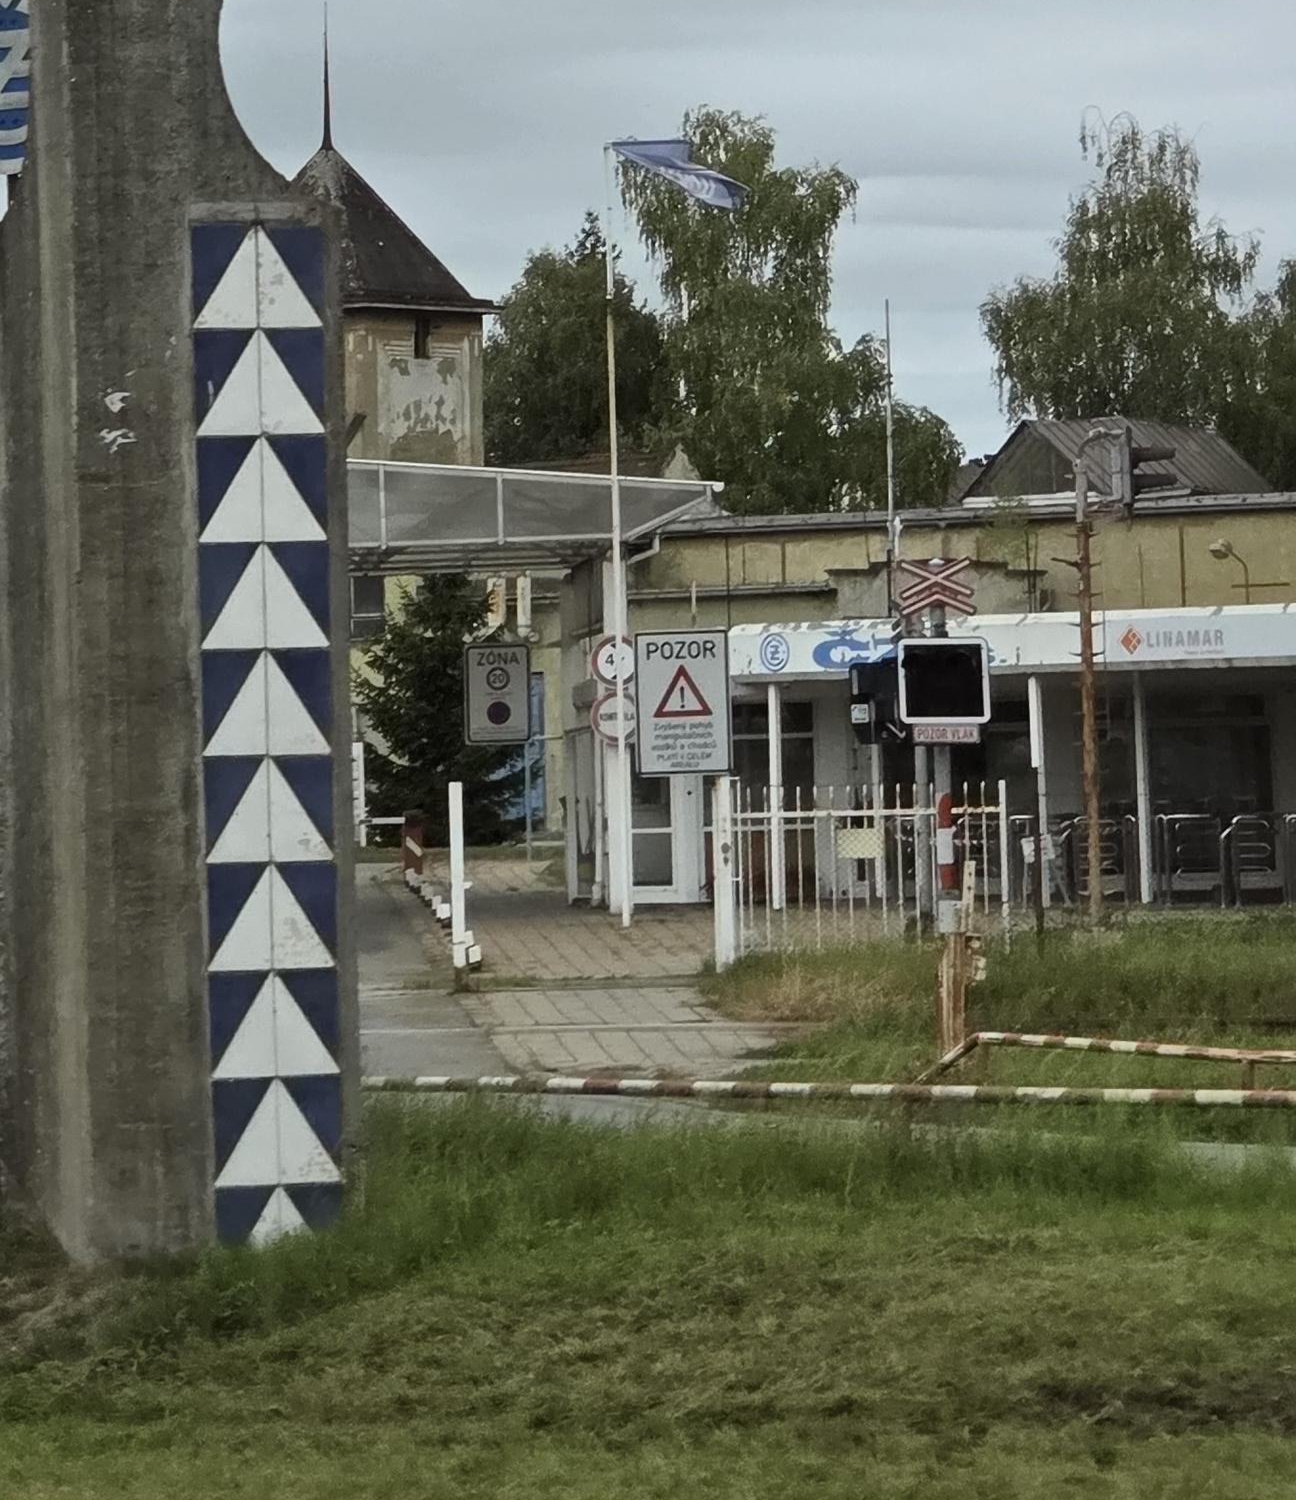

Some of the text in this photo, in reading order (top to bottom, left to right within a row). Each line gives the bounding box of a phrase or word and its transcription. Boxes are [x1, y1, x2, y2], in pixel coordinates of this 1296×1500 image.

[1146, 629, 1224, 648] LINAMAR
[476, 650, 520, 667] ZÓNA
[646, 640, 716, 660] POZOR
[491, 673, 505, 685] 20
